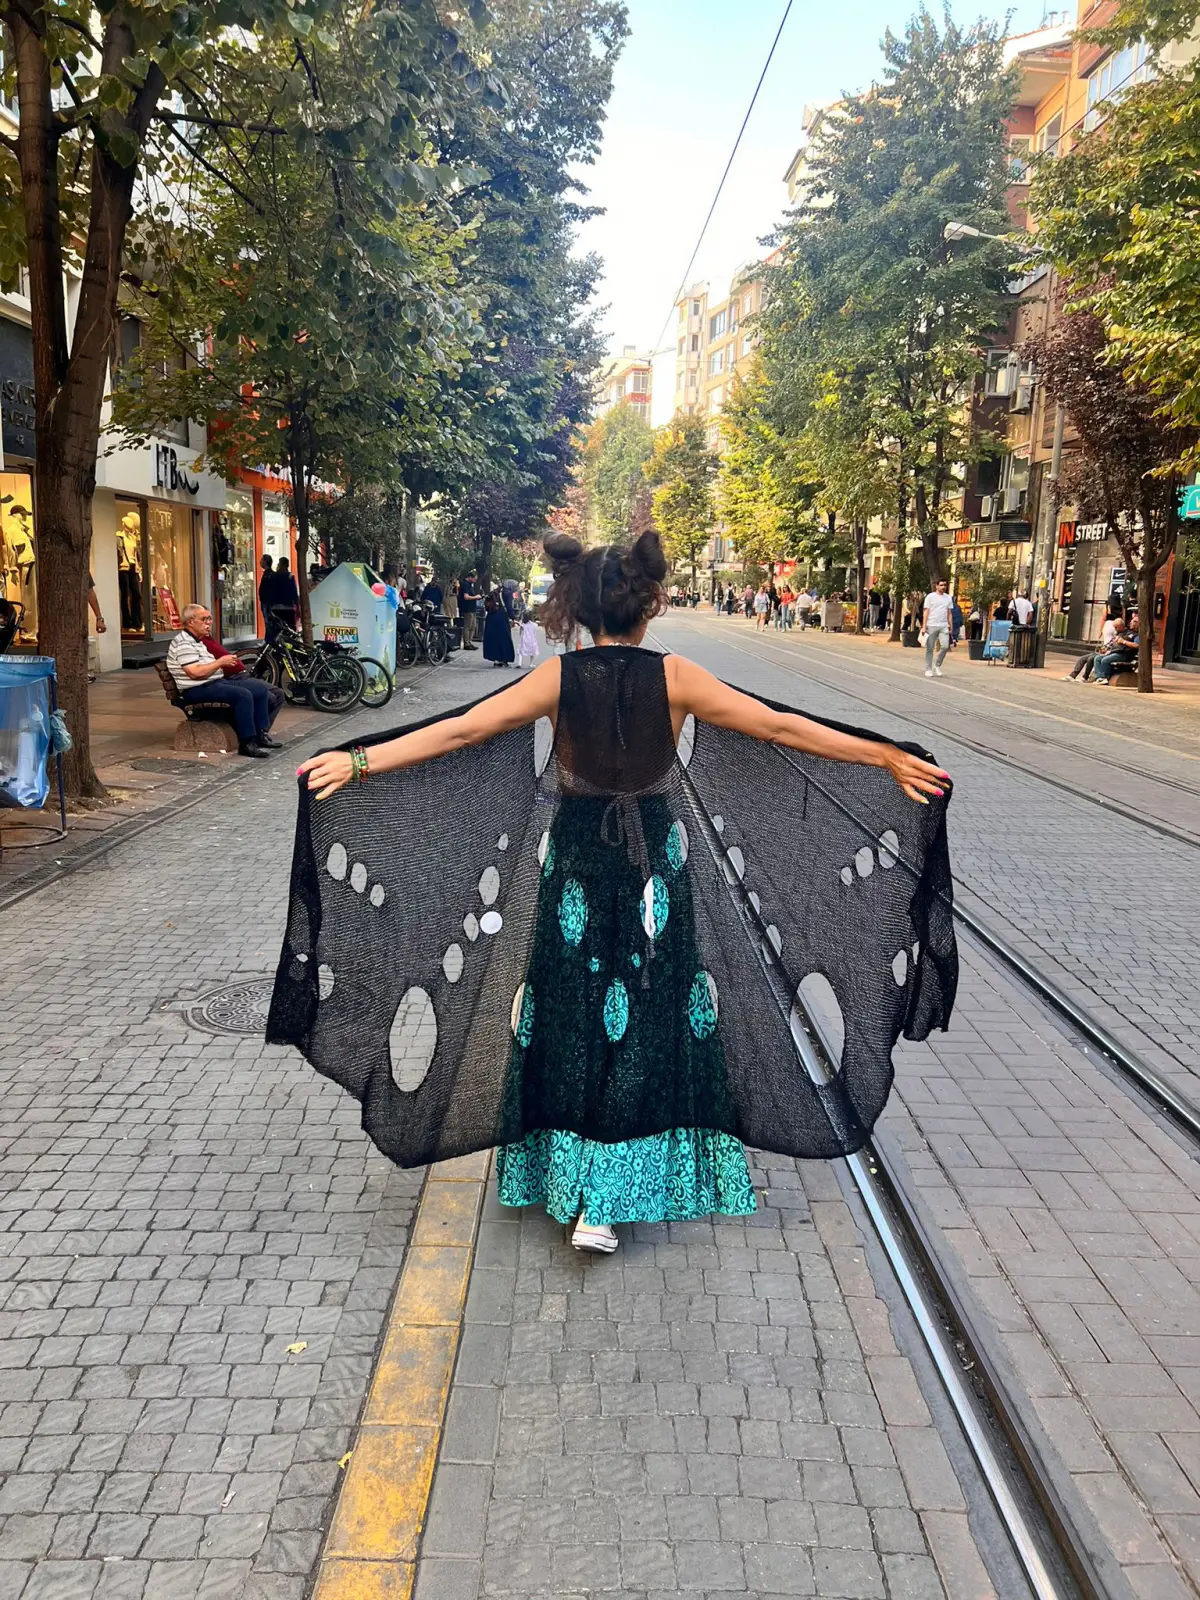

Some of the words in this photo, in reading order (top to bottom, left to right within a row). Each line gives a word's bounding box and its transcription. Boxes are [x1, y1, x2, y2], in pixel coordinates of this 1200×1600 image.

[156, 443, 178, 490] LTB
[1059, 522, 1075, 547] IN
[1075, 523, 1108, 541] STREET
